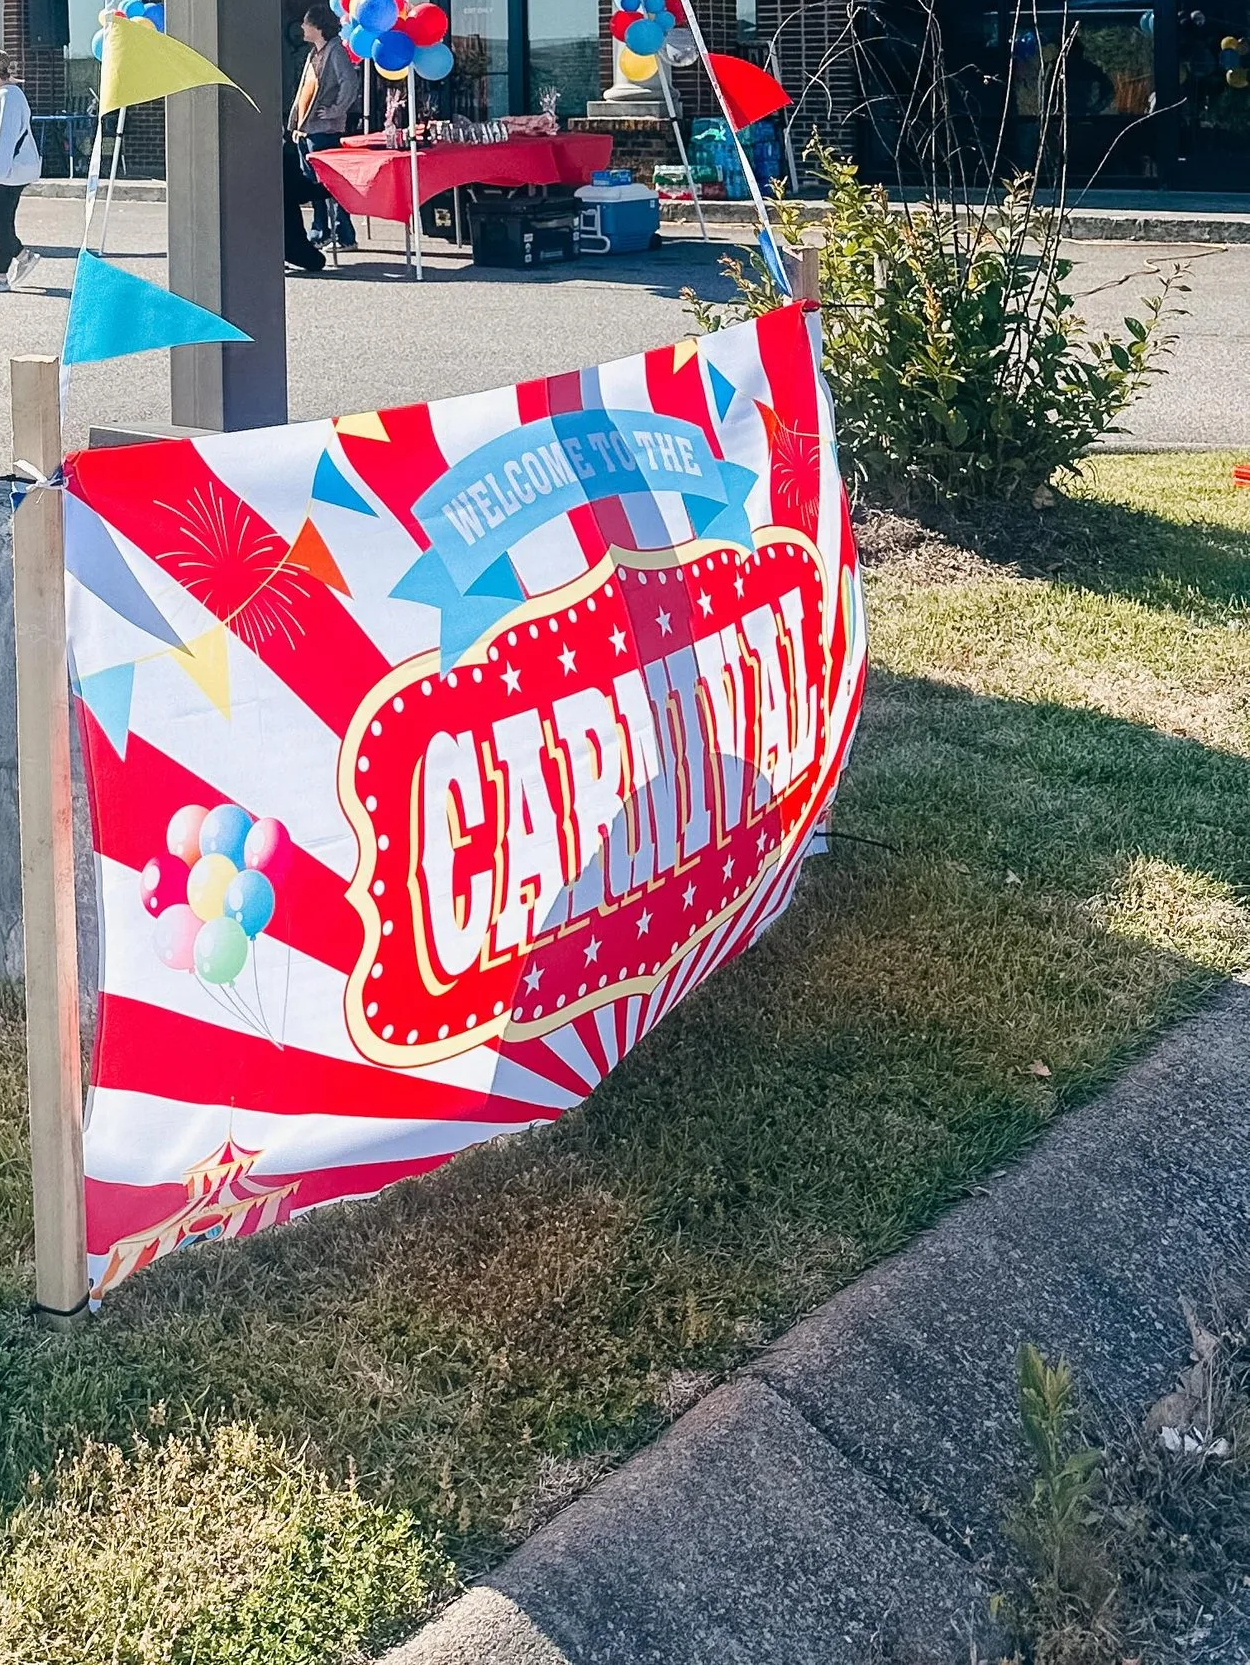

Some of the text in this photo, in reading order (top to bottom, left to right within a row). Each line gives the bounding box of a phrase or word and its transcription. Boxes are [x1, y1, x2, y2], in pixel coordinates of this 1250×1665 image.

[441, 430, 703, 547] WELCOME TO THE
[408, 586, 818, 995] CARNIVAL
